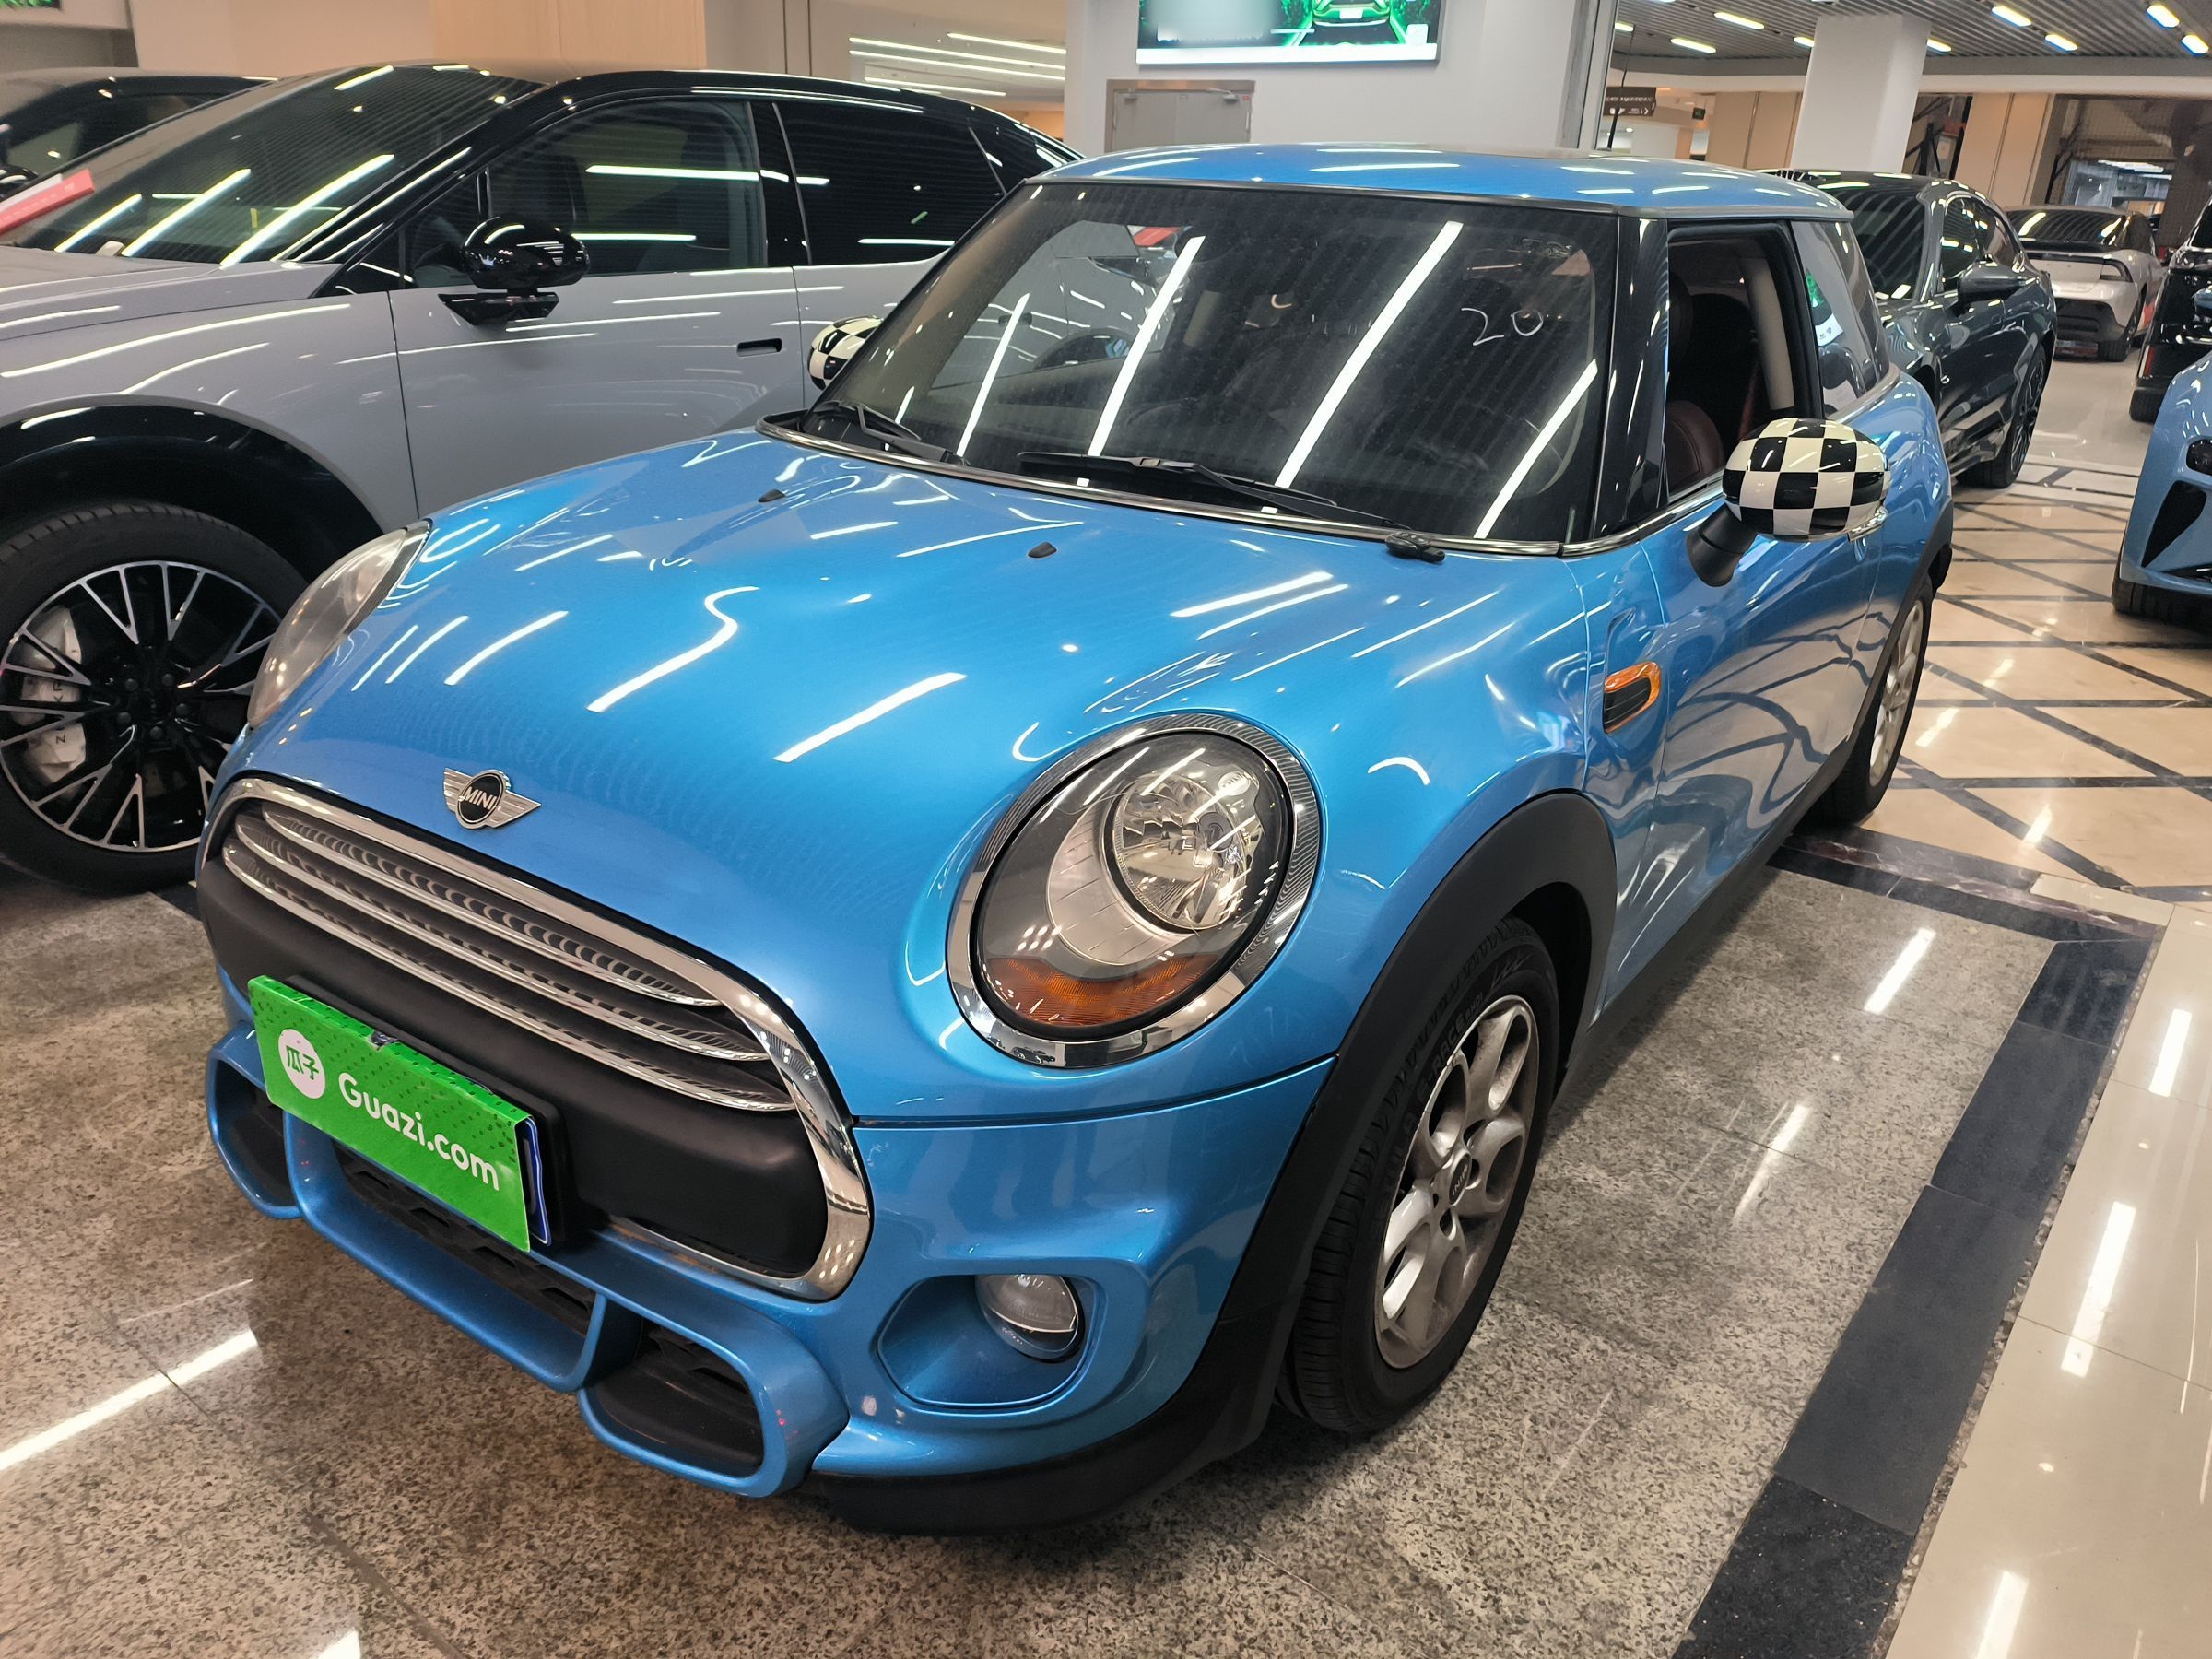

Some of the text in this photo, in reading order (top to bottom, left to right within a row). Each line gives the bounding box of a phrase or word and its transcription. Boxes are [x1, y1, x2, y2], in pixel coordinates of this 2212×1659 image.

[1461, 307, 1544, 346] 20
[464, 786, 498, 810] MINI
[287, 1045, 500, 1191] 瓜子 Guazi.com
[1452, 1164, 1468, 1195] MINI
